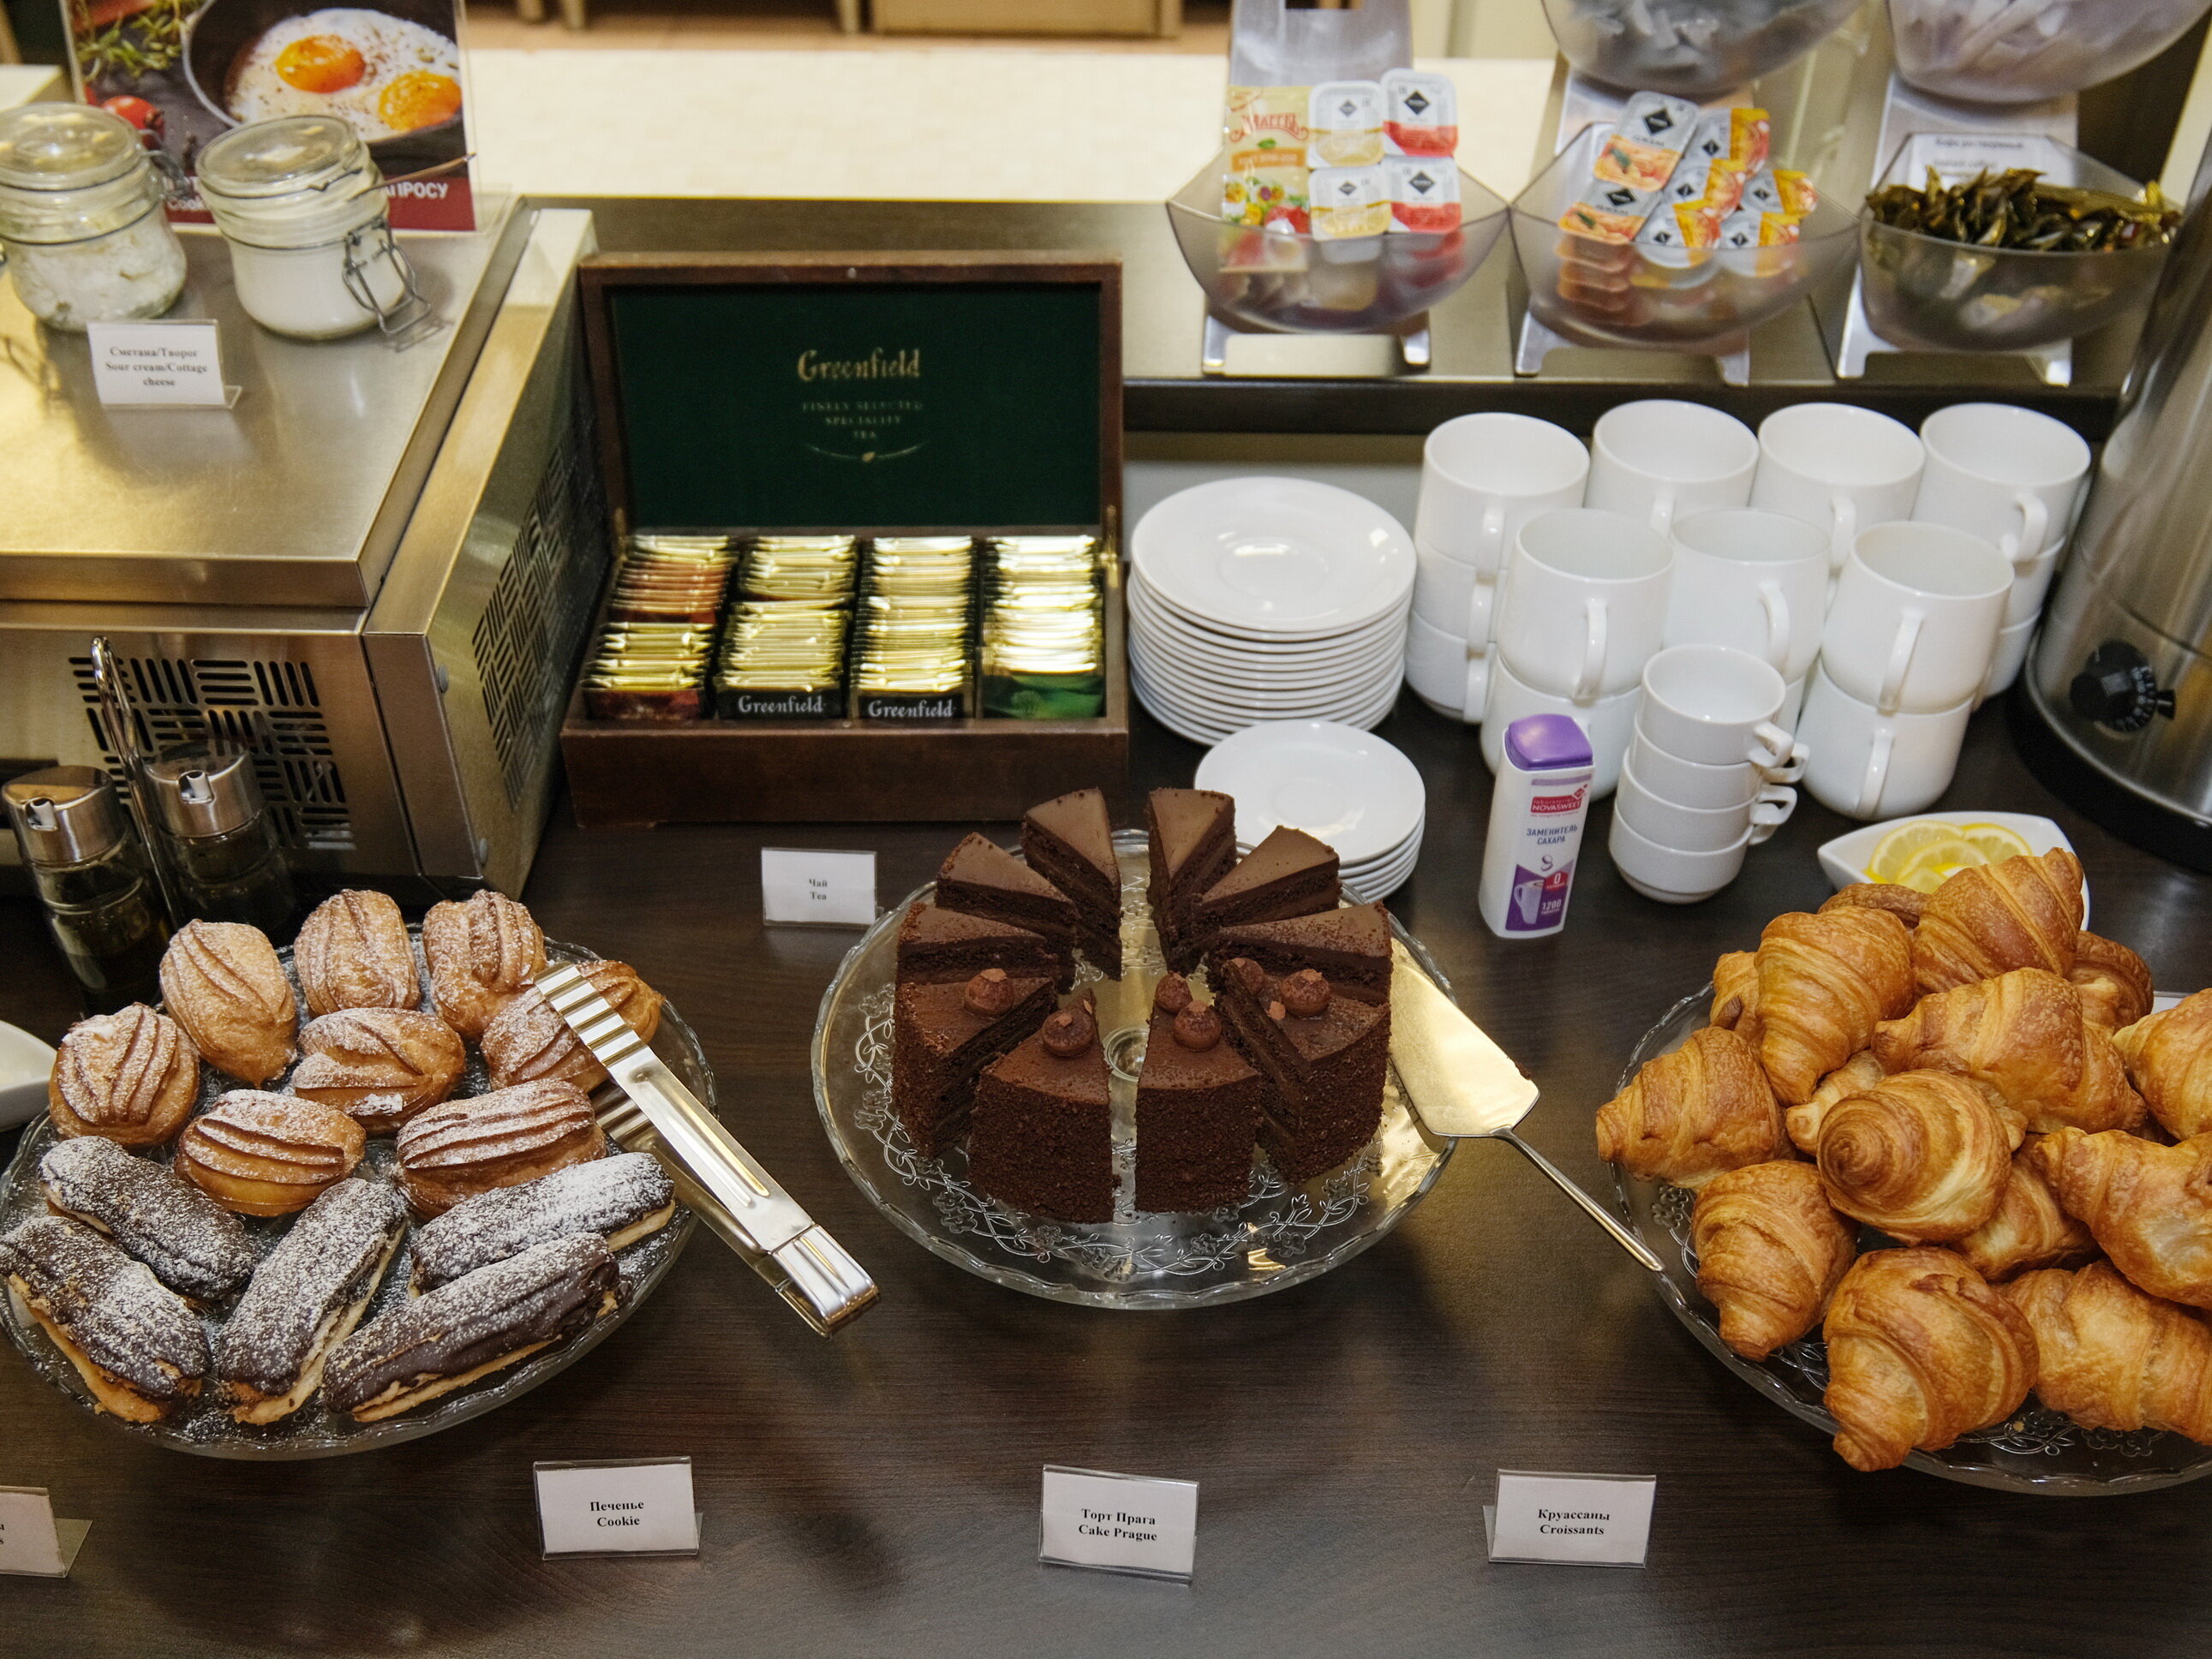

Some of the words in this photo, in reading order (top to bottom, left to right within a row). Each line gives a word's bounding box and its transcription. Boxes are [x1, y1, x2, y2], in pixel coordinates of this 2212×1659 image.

[105, 361, 129, 371] Sour
[798, 347, 921, 382] Greenfield
[142, 377, 176, 386] cheese
[738, 695, 823, 713] Greenfield
[868, 699, 953, 718] Greenfield
[1532, 801, 1581, 812] NOVASWEET
[1527, 824, 1578, 837] ЗАМЕНИТЕЛЬ
[1537, 835, 1566, 845] САХАРА
[809, 878, 828, 887] Чай
[810, 891, 828, 900] Tea
[589, 1501, 644, 1512] Печенье
[1081, 1508, 1113, 1523] Торт
[1115, 1512, 1156, 1525] Прага
[1537, 1508, 1610, 1522] Круассаны
[596, 1516, 641, 1527] Cookie
[1078, 1524, 1110, 1537] Cake
[1114, 1528, 1157, 1542] Prague
[1539, 1524, 1605, 1536] Croissants
